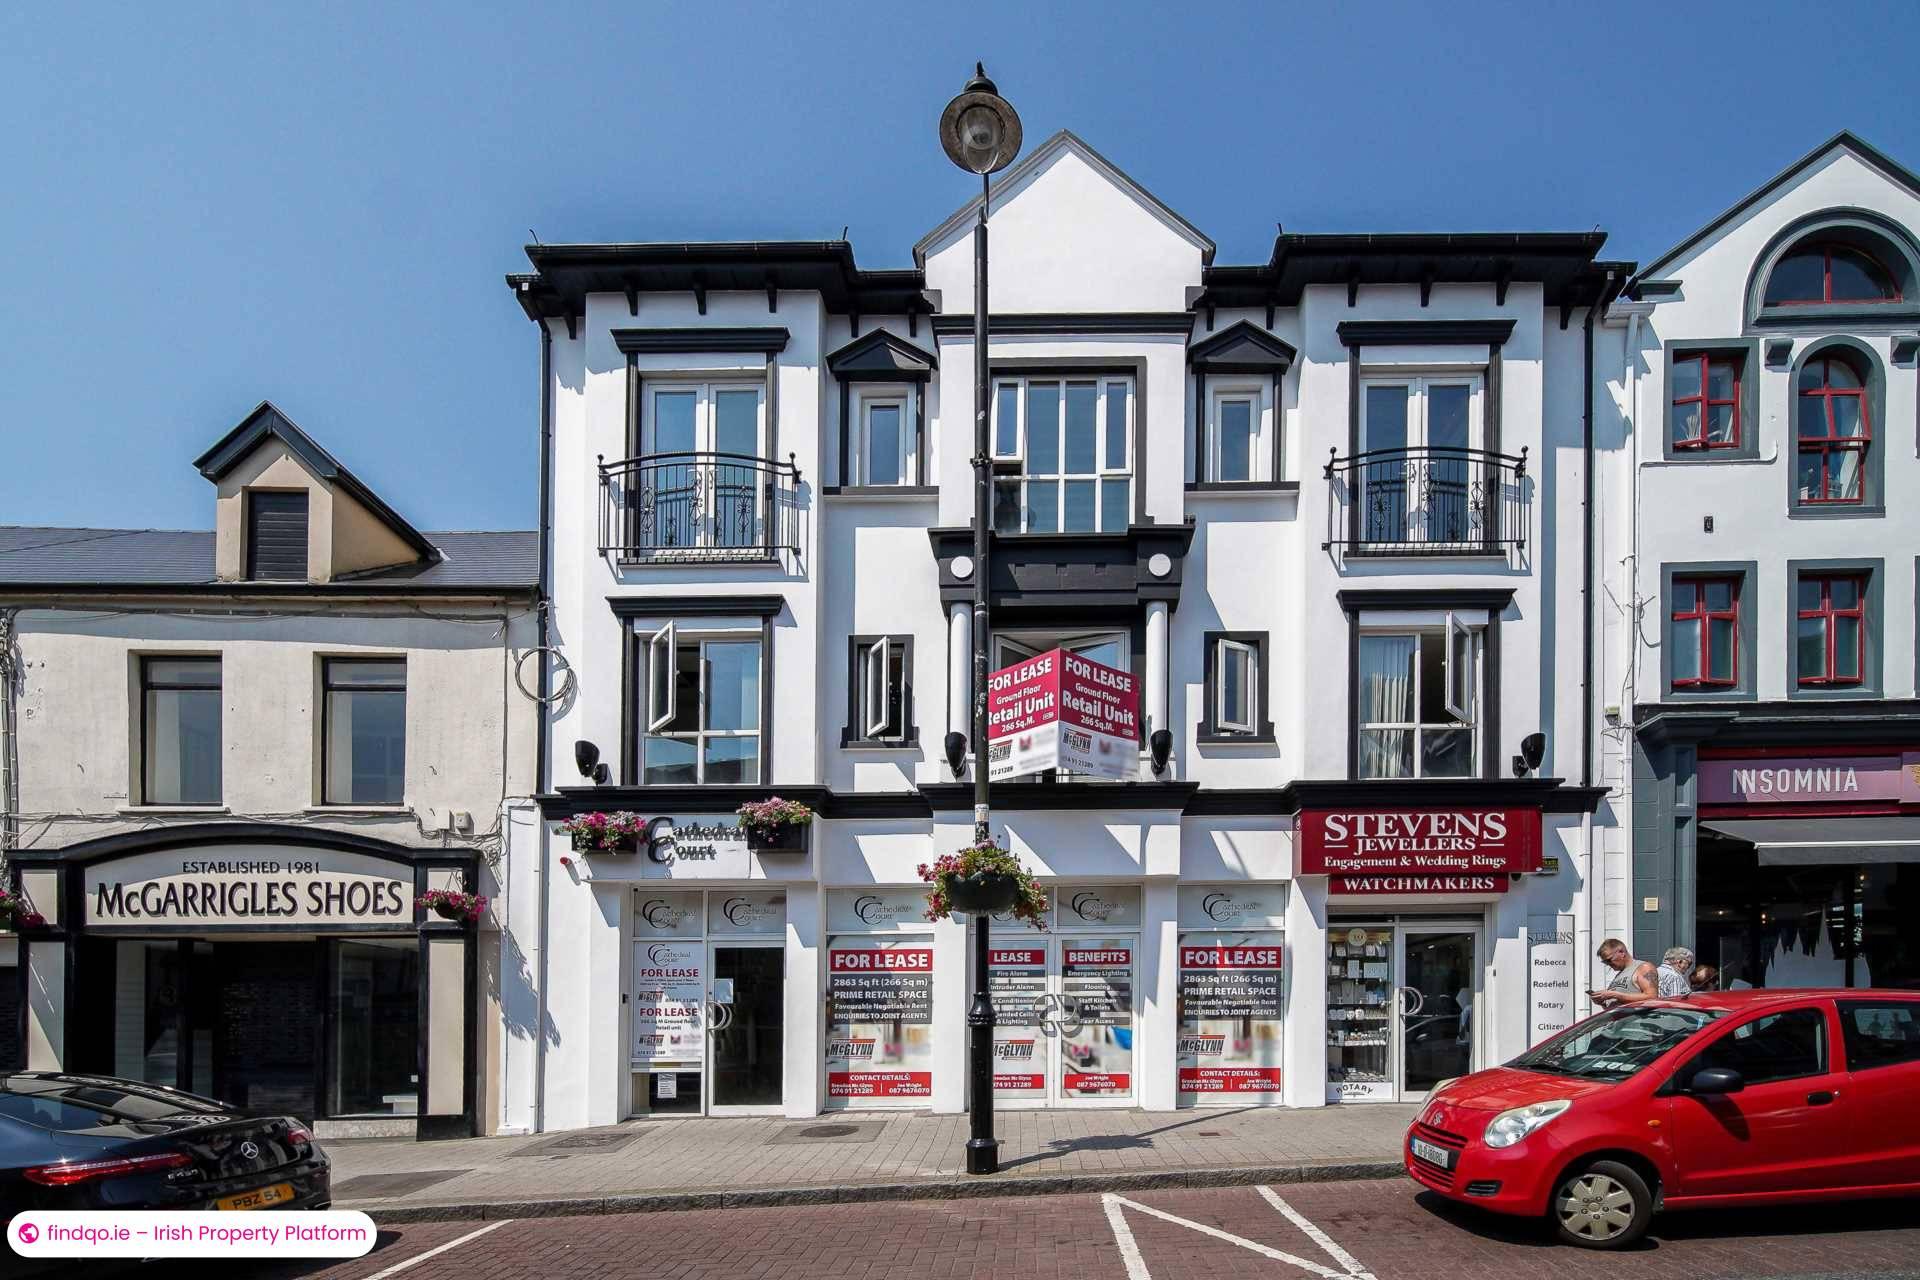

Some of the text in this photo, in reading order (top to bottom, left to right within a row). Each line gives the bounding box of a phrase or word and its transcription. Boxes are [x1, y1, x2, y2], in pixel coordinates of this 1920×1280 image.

[988, 657, 1052, 693] FOR LEASE
[1065, 657, 1131, 693] FOR LEASE
[996, 684, 1041, 704] Ground Floor
[1075, 683, 1120, 704] Ground Floor
[1025, 691, 1054, 714] Unit
[1062, 690, 1134, 726] Retail Unit
[1732, 768, 1858, 793] INSOMNIA
[1325, 813, 1507, 841] STEVENS
[648, 836, 716, 864] Court
[1354, 837, 1476, 855] JEWELLERS
[183, 861, 320, 874] ESTABLISHED 1981
[1325, 855, 1506, 869] Engagement & Wedding Rings
[1344, 877, 1495, 890] WATCHMAKERS
[96, 880, 404, 917] McGARRIGLES SHOES
[835, 954, 928, 968] FOR LEASE
[993, 953, 1031, 962] LEASE
[1069, 952, 1126, 962] BENEFITS
[1185, 951, 1277, 964] FOR LEASE
[641, 968, 699, 977] FOR LEASE
[858, 979, 869, 987] Sq
[881, 979, 900, 987] (266
[903, 979, 914, 987] Sq
[917, 979, 928, 987] m)
[1208, 976, 1219, 984] Sq
[1231, 975, 1250, 983] (266
[1252, 976, 1264, 984] Sq
[1265, 975, 1277, 983] m)
[1533, 980, 1569, 988] Rosefield
[834, 991, 927, 999] PRIME RETAIL SPACE
[1538, 1001, 1565, 1009] Rotary
[640, 1008, 698, 1016] FOR LEASE
[1538, 1023, 1565, 1031] Citizen
[829, 1043, 874, 1056] McGLYNN
[1181, 1040, 1223, 1051] McGLYNN
[1336, 1084, 1373, 1094] ROTARY
[232, 1194, 262, 1209] PBZ
